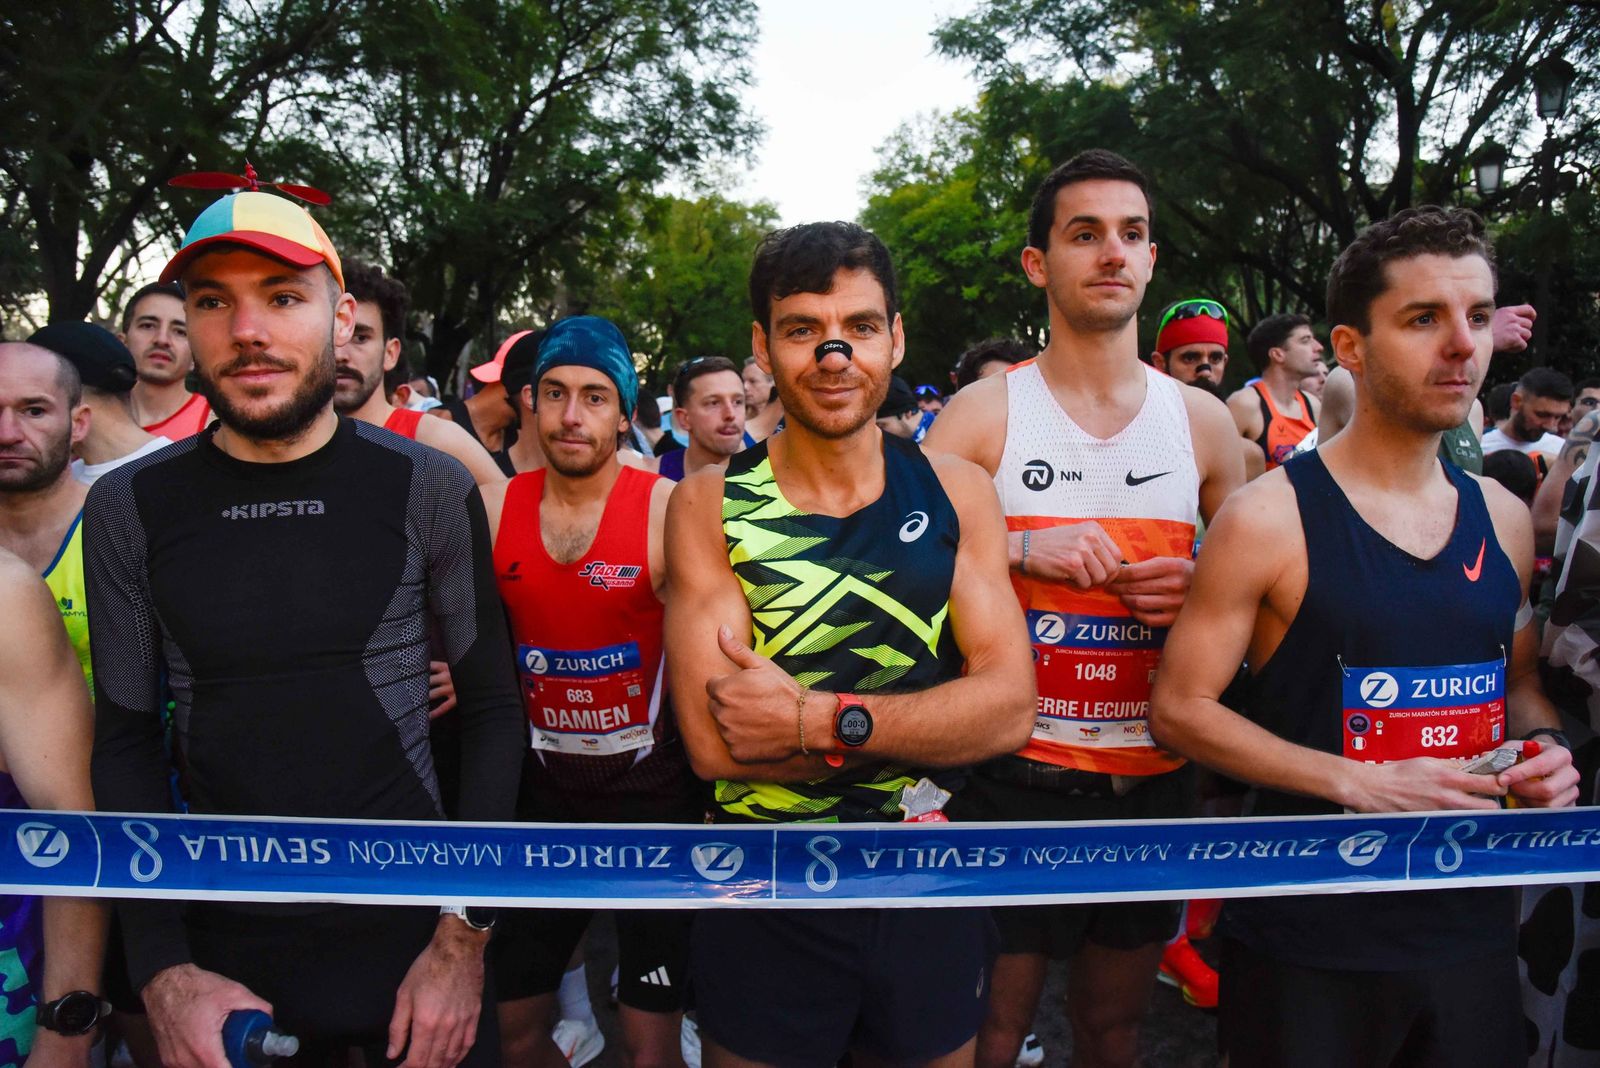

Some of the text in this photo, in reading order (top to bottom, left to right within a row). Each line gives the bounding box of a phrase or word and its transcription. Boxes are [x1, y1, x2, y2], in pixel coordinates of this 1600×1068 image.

[1060, 471, 1083, 482] NN
[1075, 623, 1152, 641] ZURICH
[555, 651, 625, 671] ZURICH
[1074, 663, 1117, 681] 1048
[566, 688, 594, 704] 683
[1411, 673, 1496, 698] ZURICH
[543, 704, 630, 730] DAMIEN
[1411, 710, 1440, 718] MARATÓN
[1420, 725, 1459, 748] 832
[179, 834, 332, 865] SEVILLA
[348, 840, 502, 871] MARATÓN
[525, 844, 672, 869] ZURICH
[860, 846, 1010, 870] SEVILLA
[1024, 843, 1171, 871] MARATÓN
[1186, 838, 1327, 861] ZURICH
